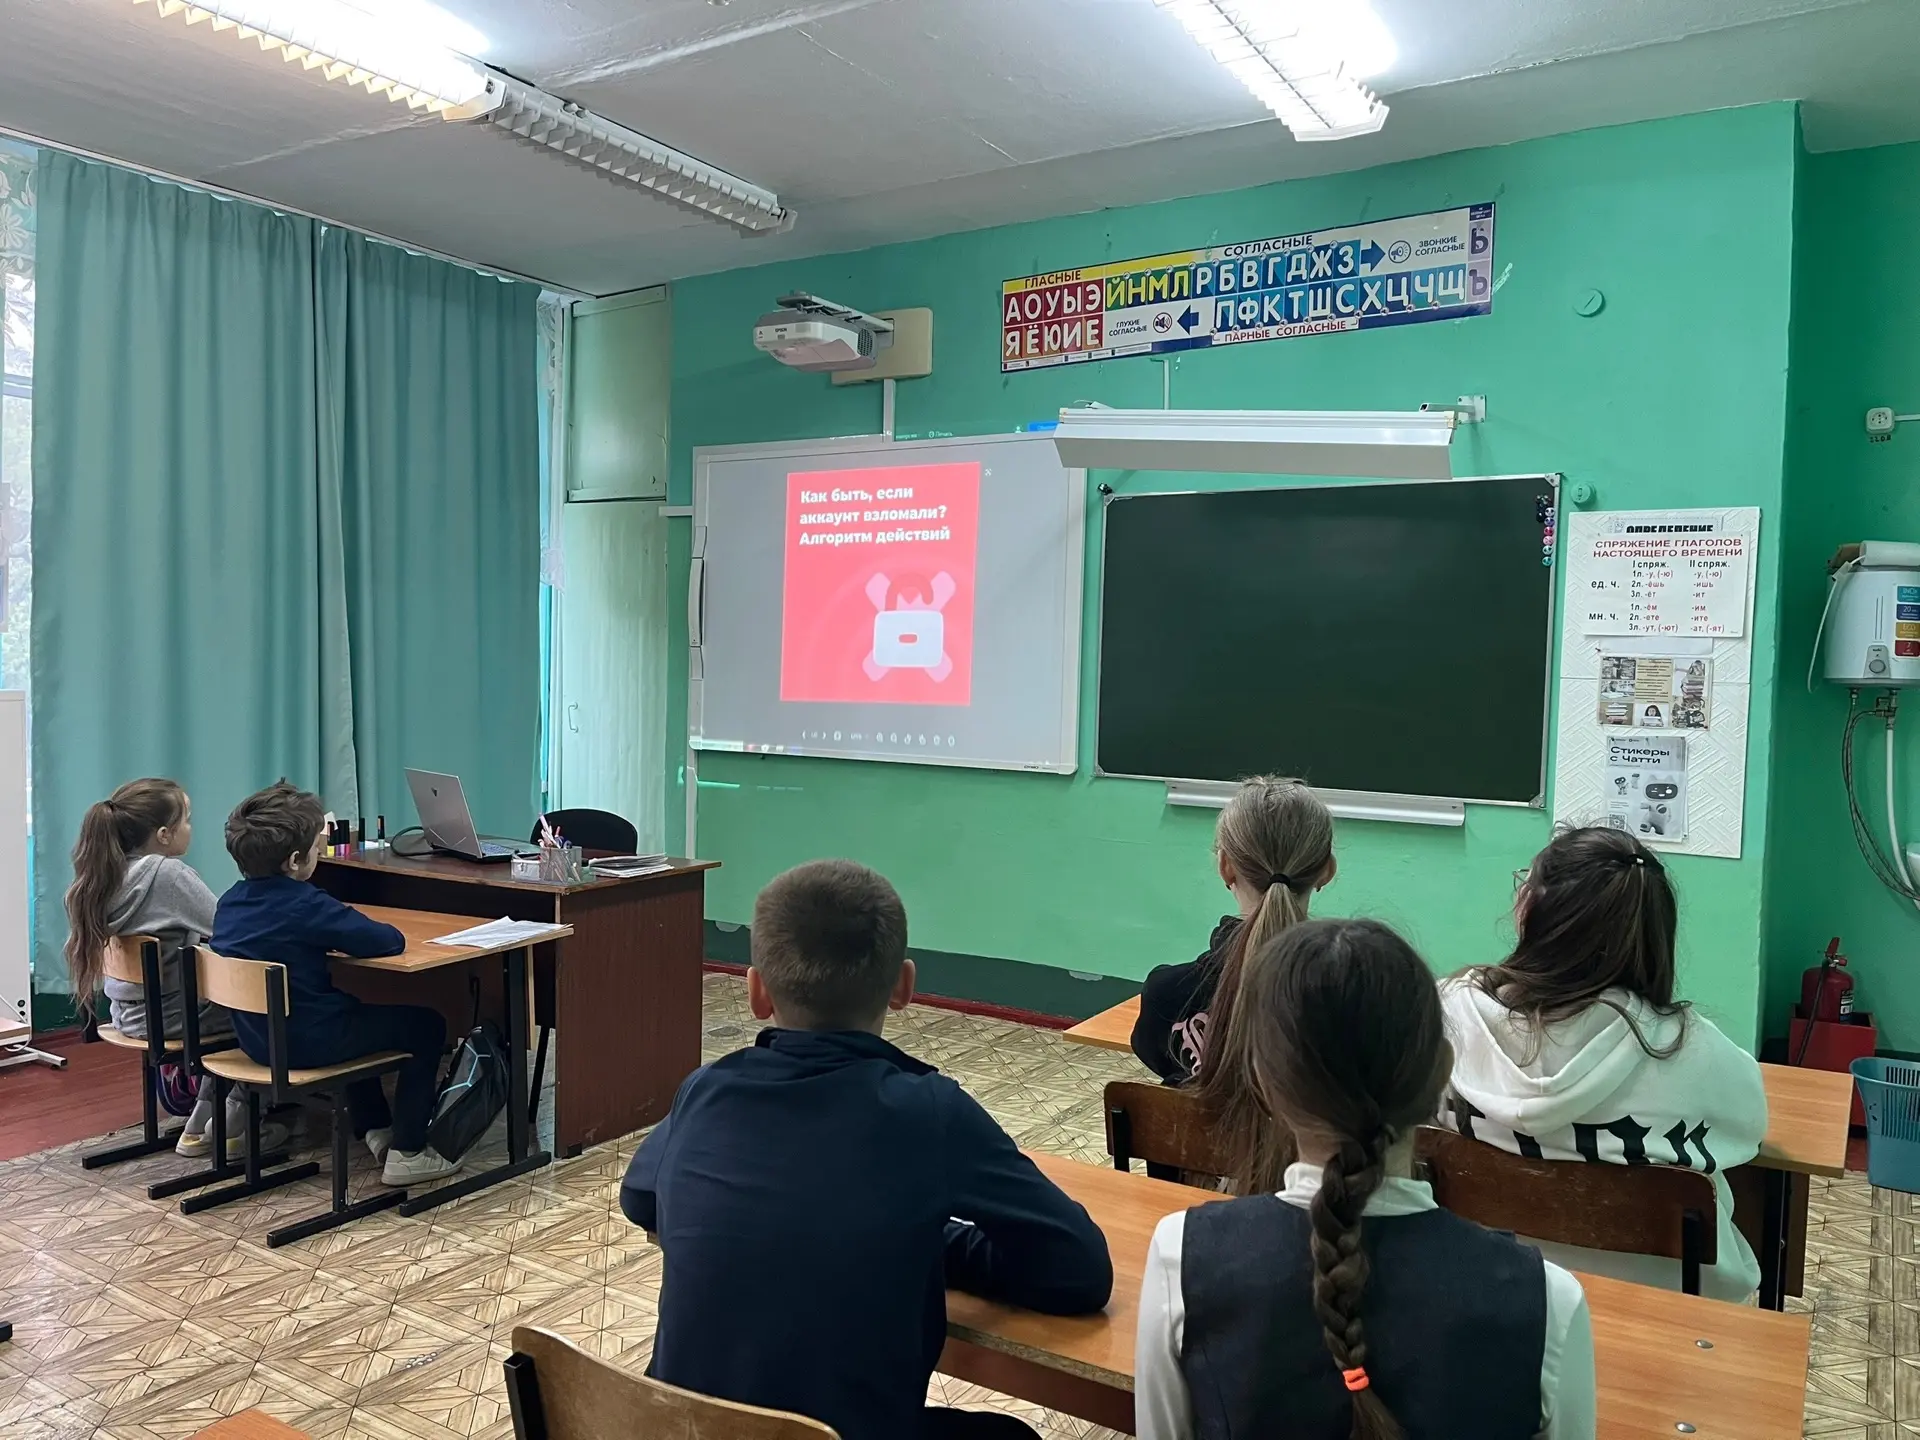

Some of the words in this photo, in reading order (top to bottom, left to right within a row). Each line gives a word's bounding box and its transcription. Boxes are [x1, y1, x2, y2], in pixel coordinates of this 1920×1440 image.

[1224, 235, 1312, 257] СОГЛАСНЫЕ
[1419, 236, 1457, 248] ЗВОНКИЕ
[1415, 243, 1465, 256] СОГЛАСНЫЕ
[1025, 270, 1081, 288] ГЛАСНЫЕ
[1116, 319, 1140, 328] ГЛУХИЕ
[1109, 325, 1148, 337] СОГЛАСНЫЕ
[1225, 329, 1270, 342] ПАРНЫЕ
[1277, 321, 1346, 336] СОГЛАСНЫЕ
[801, 491, 827, 503] Как
[832, 488, 872, 503] быть,
[877, 488, 913, 499] если
[800, 512, 860, 526] аккаунт
[864, 505, 947, 521] взломали?
[799, 532, 872, 547] Алгоритм
[875, 526, 950, 544] действий
[1595, 539, 1671, 548] СПРЯЖЕНИЕ
[1675, 539, 1742, 547] ГЛАГОЛОВ
[1593, 549, 1677, 558] НАСТОЯЩЕГО
[1681, 549, 1743, 557] ВРЕМЕНИ
[1638, 561, 1670, 569] спряж.
[1697, 561, 1731, 569] спряж.
[1591, 581, 1607, 589] ед.
[1658, 624, 1679, 632] (-ют)
[1610, 746, 1670, 756] Стикеры
[1622, 755, 1660, 763] Чатти
